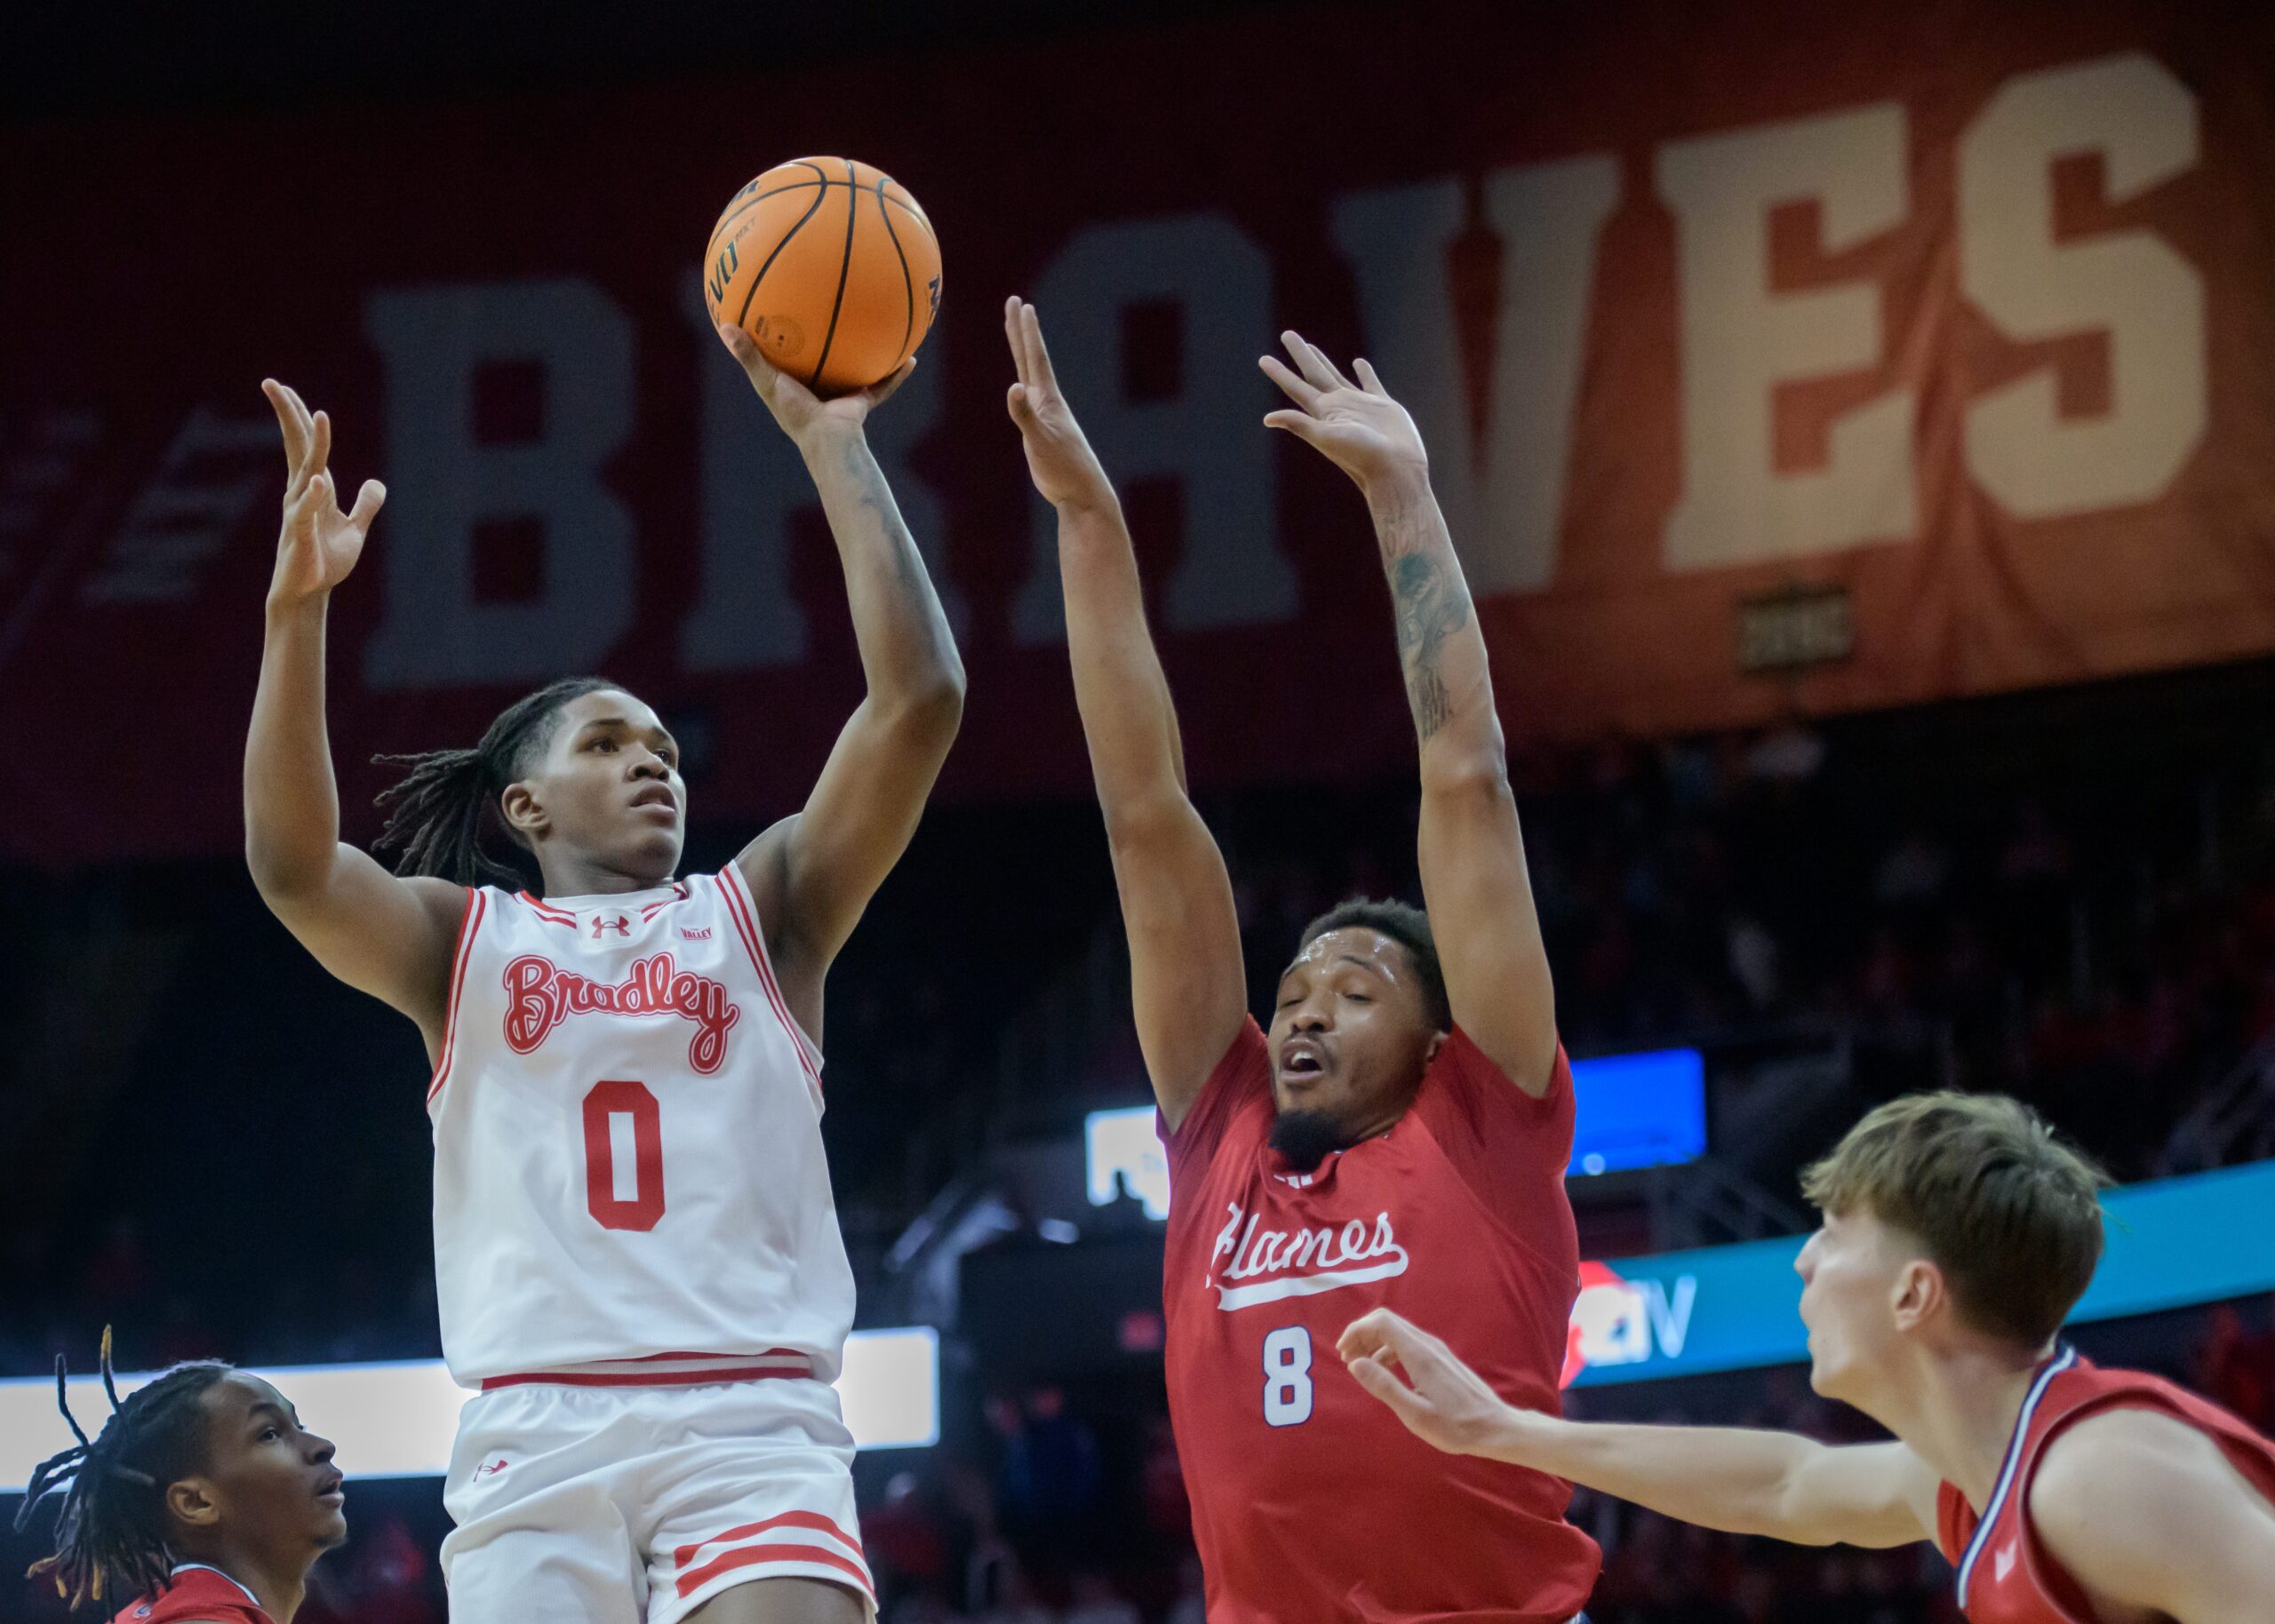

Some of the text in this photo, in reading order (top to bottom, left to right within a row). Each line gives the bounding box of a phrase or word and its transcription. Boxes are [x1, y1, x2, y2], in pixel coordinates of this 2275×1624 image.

[359, 51, 2209, 689] BRAVES
[680, 927, 712, 939] VALLEY
[503, 951, 741, 1075] Bradley
[582, 1080, 666, 1231] 0
[1262, 1325, 1313, 1428] 8
